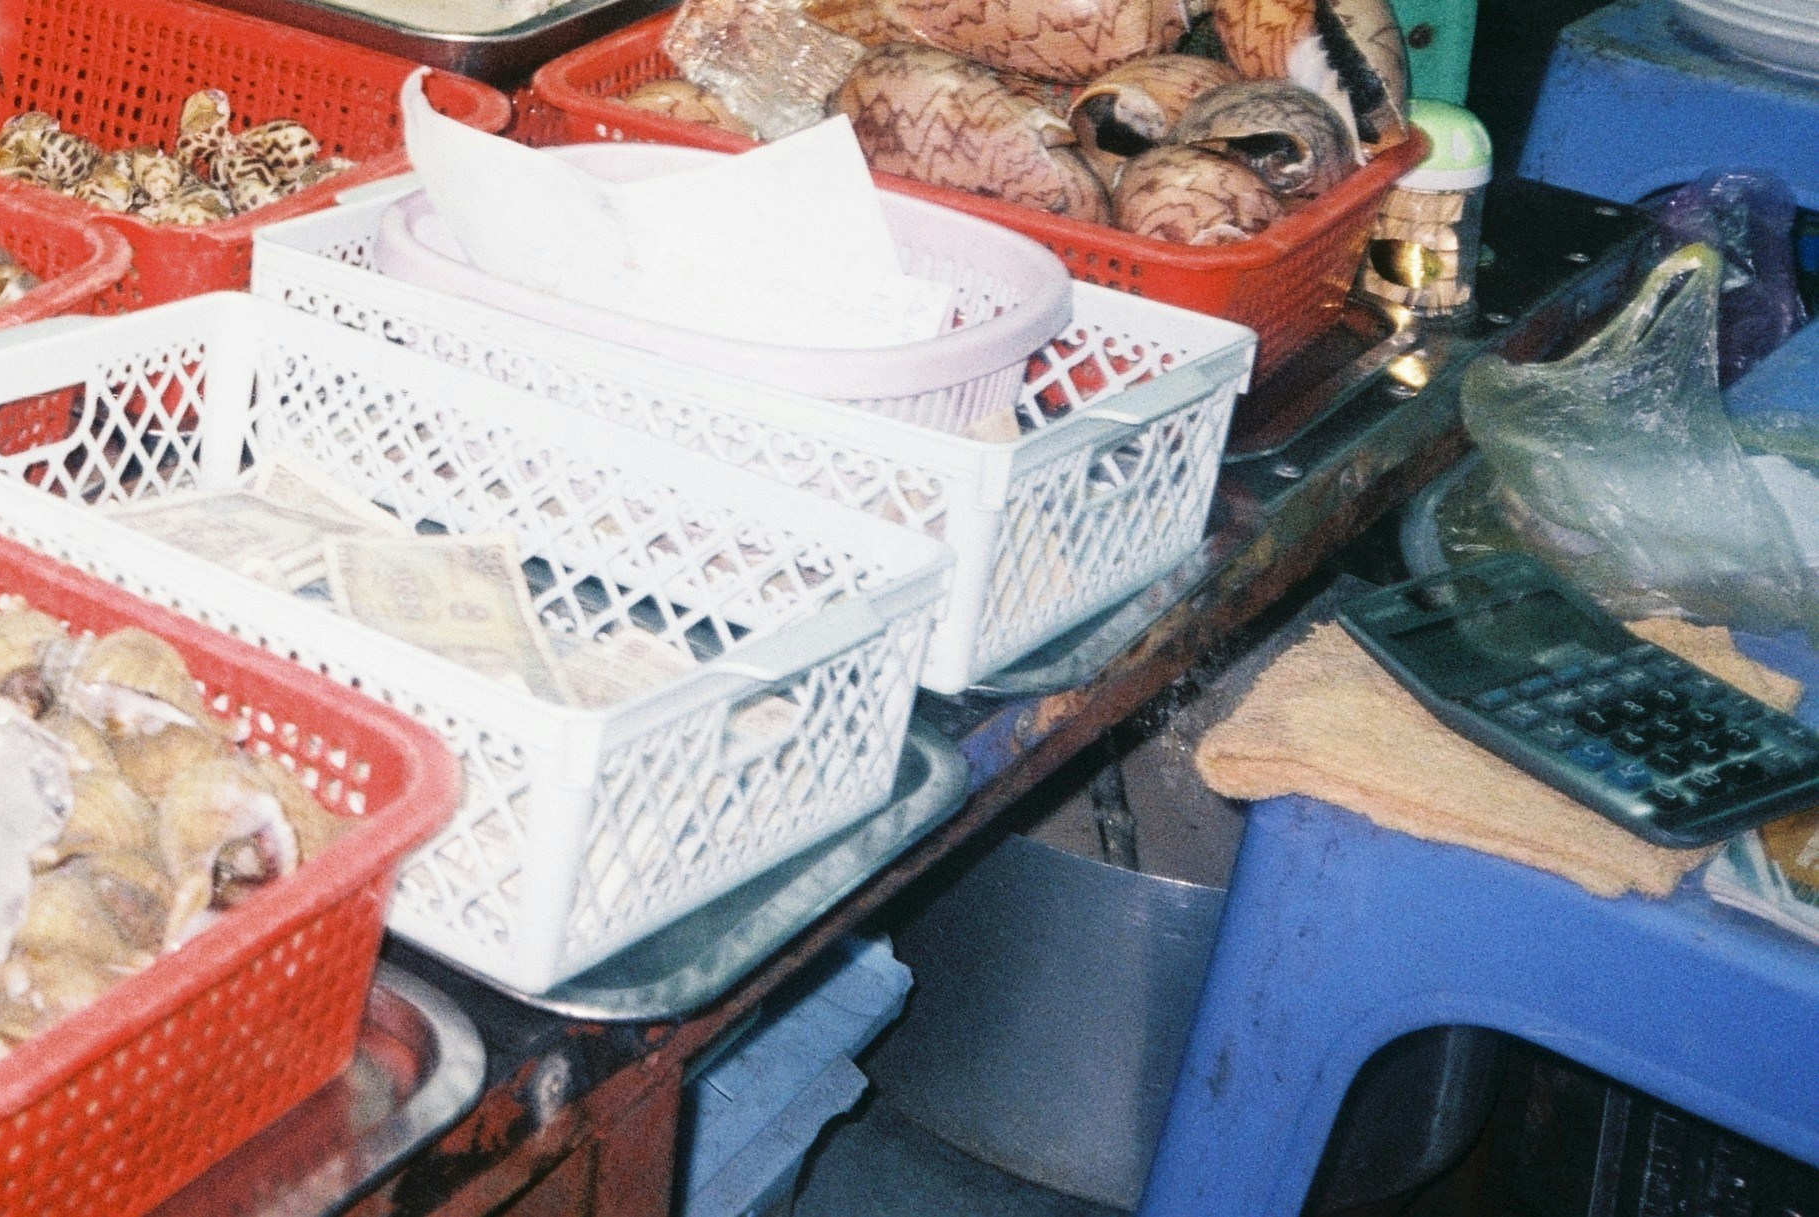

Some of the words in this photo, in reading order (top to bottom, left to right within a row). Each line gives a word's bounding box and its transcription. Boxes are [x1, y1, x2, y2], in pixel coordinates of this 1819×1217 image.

[1587, 709, 1606, 724] 7
[1622, 700, 1645, 713] 8
[1657, 689, 1677, 702] 9
[1584, 743, 1605, 758] C
[1626, 731, 1645, 744] 4
[1657, 719, 1679, 732] 5
[1697, 710, 1715, 722] 6
[1660, 752, 1679, 764] 1
[1694, 740, 1718, 754] 2
[1729, 728, 1751, 742] 3
[1657, 785, 1677, 799] 0
[1691, 769, 1721, 786] 00
